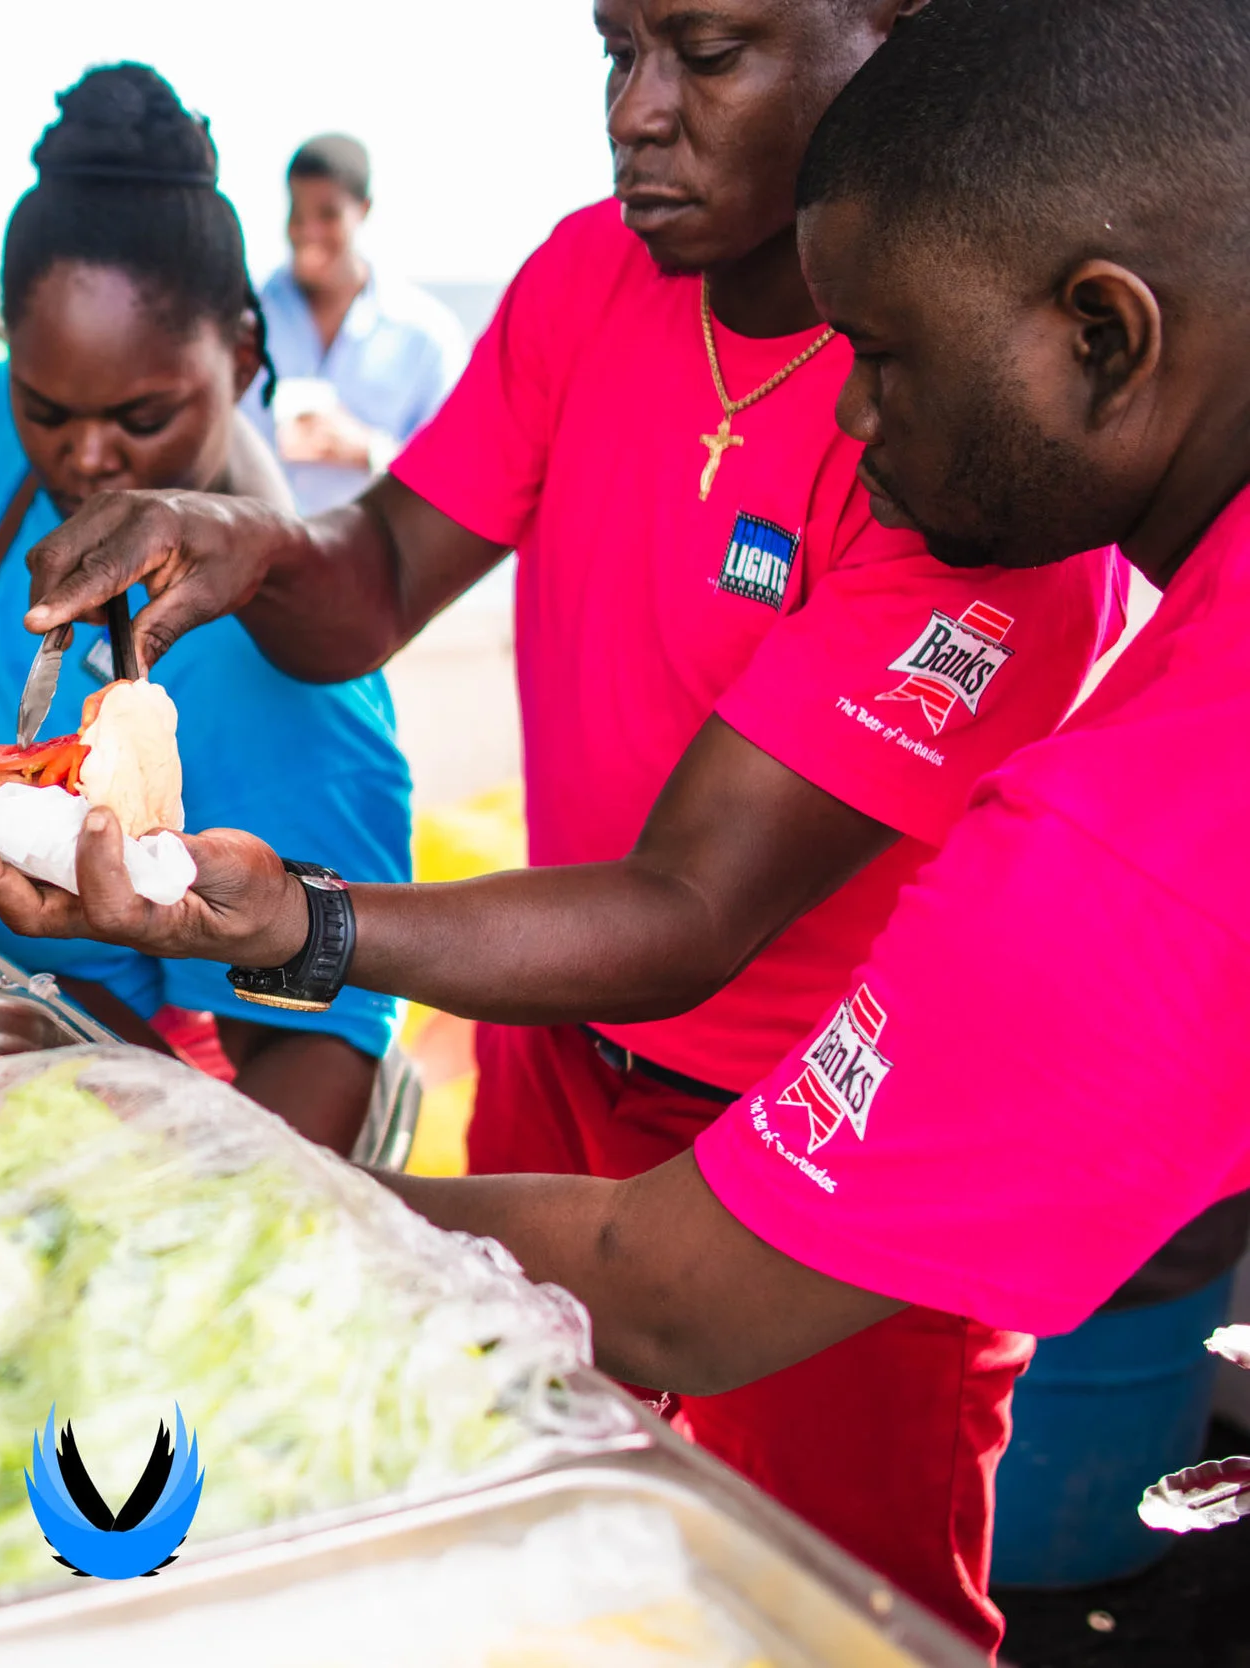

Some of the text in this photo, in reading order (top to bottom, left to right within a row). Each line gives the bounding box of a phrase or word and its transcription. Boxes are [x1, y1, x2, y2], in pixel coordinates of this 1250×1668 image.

[724, 541, 788, 596] LIGHTS
[907, 622, 995, 695] Banks
[835, 696, 945, 766] The Beer of Barbados
[750, 1095, 765, 1114] The
[761, 1130, 780, 1149] of
[775, 1139, 838, 1194] Barbados
